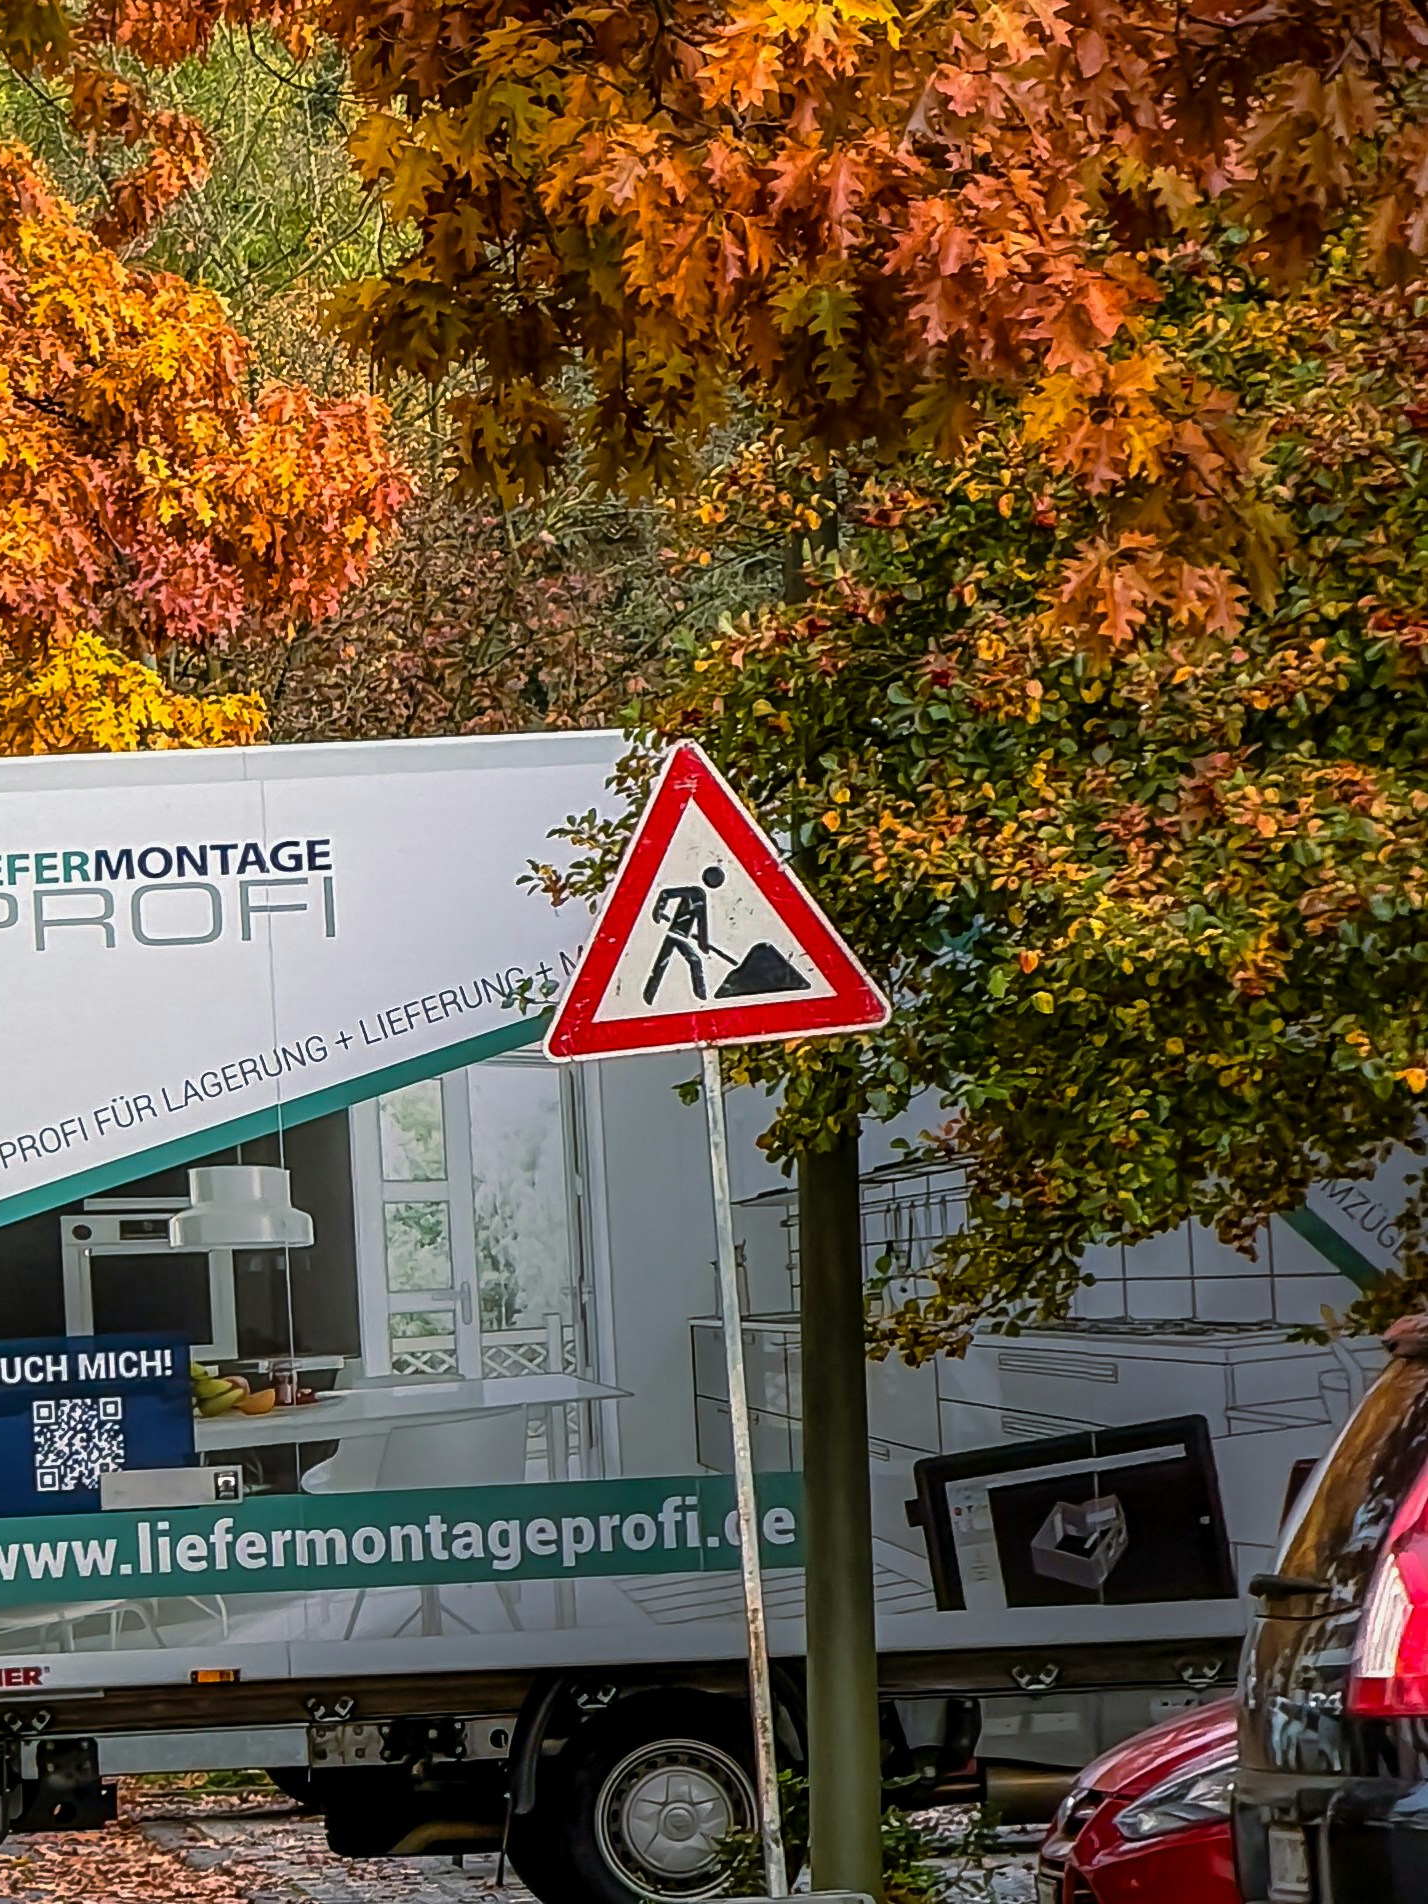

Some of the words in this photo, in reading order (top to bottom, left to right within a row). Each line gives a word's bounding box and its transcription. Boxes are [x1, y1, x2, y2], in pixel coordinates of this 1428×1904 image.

[93, 1094, 159, 1136] FÜR
[161, 1035, 329, 1113] LAGERUNG
[78, 1348, 174, 1382] MICH!
